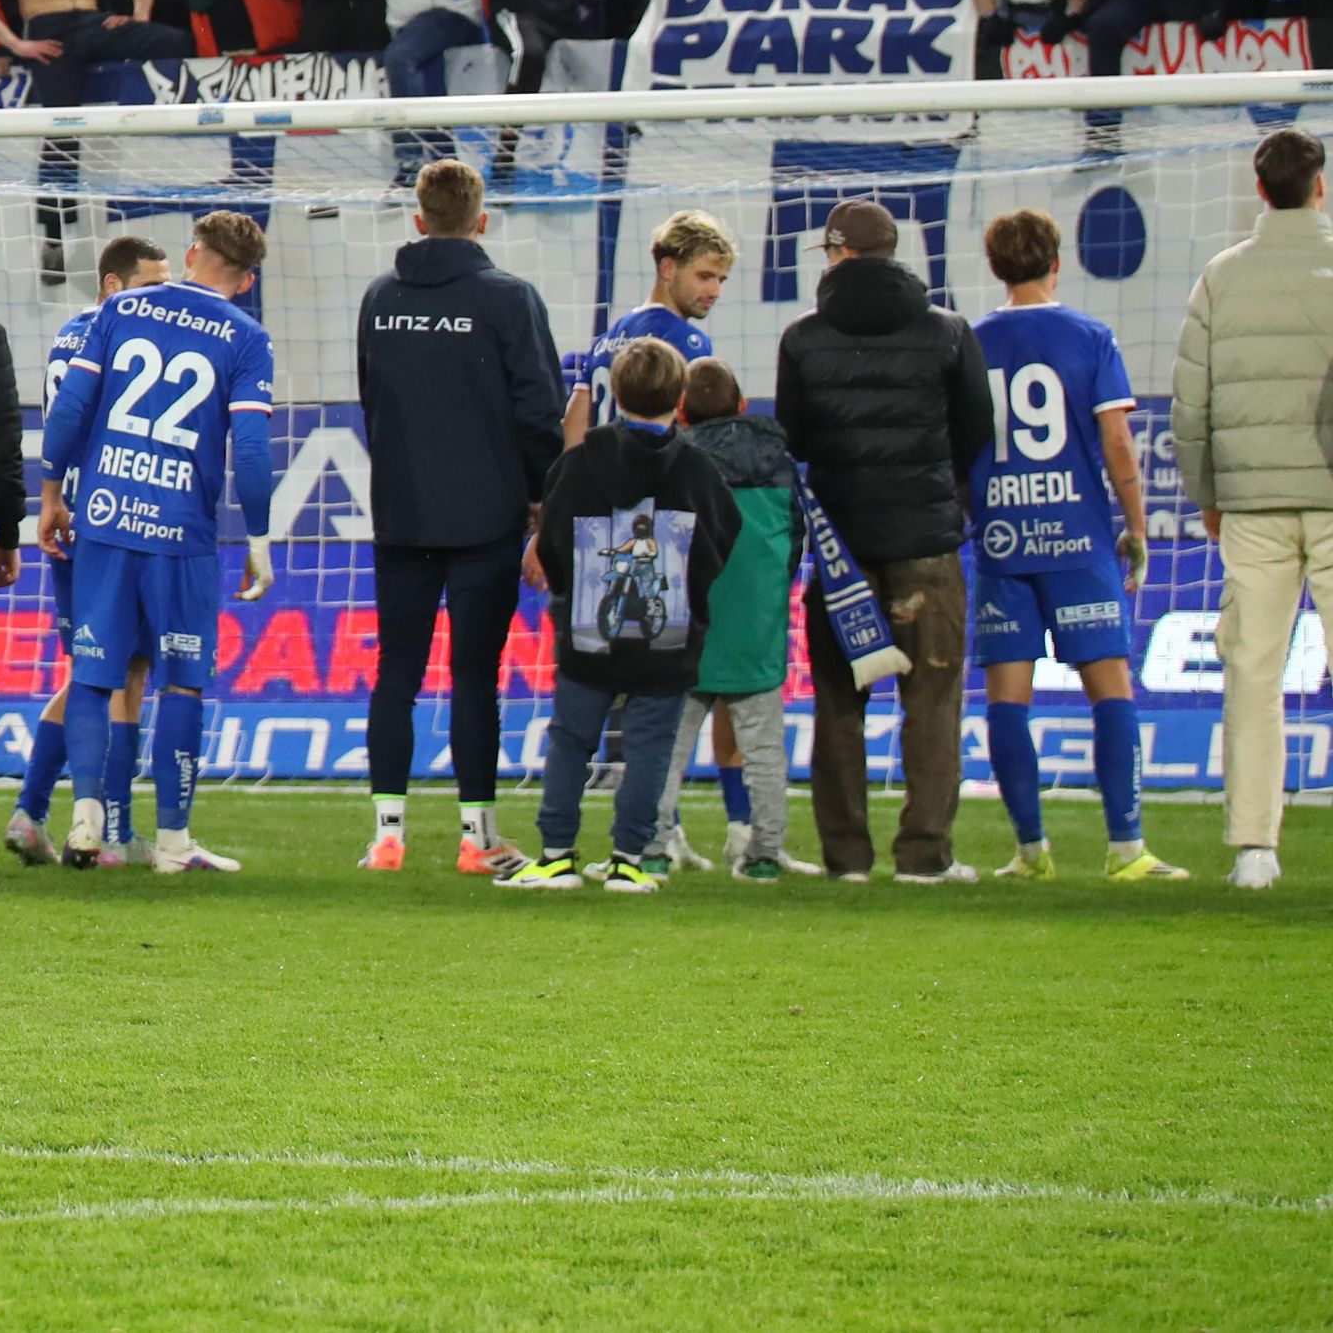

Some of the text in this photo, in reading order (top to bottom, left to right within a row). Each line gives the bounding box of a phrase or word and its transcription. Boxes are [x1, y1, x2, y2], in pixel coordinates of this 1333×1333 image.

[651, 16, 956, 77] PARK
[116, 296, 238, 344] Oberbank
[374, 315, 473, 333] LINZ AG
[106, 337, 217, 451] 22
[988, 362, 1068, 463] 19
[97, 444, 194, 493] RIEGLER
[120, 494, 160, 518] Linz
[986, 469, 1082, 509] BRIEDL
[116, 514, 185, 543] Airport
[1021, 519, 1064, 537] Linz
[1022, 533, 1093, 559] Airport
[1054, 600, 1121, 626] LEEB
